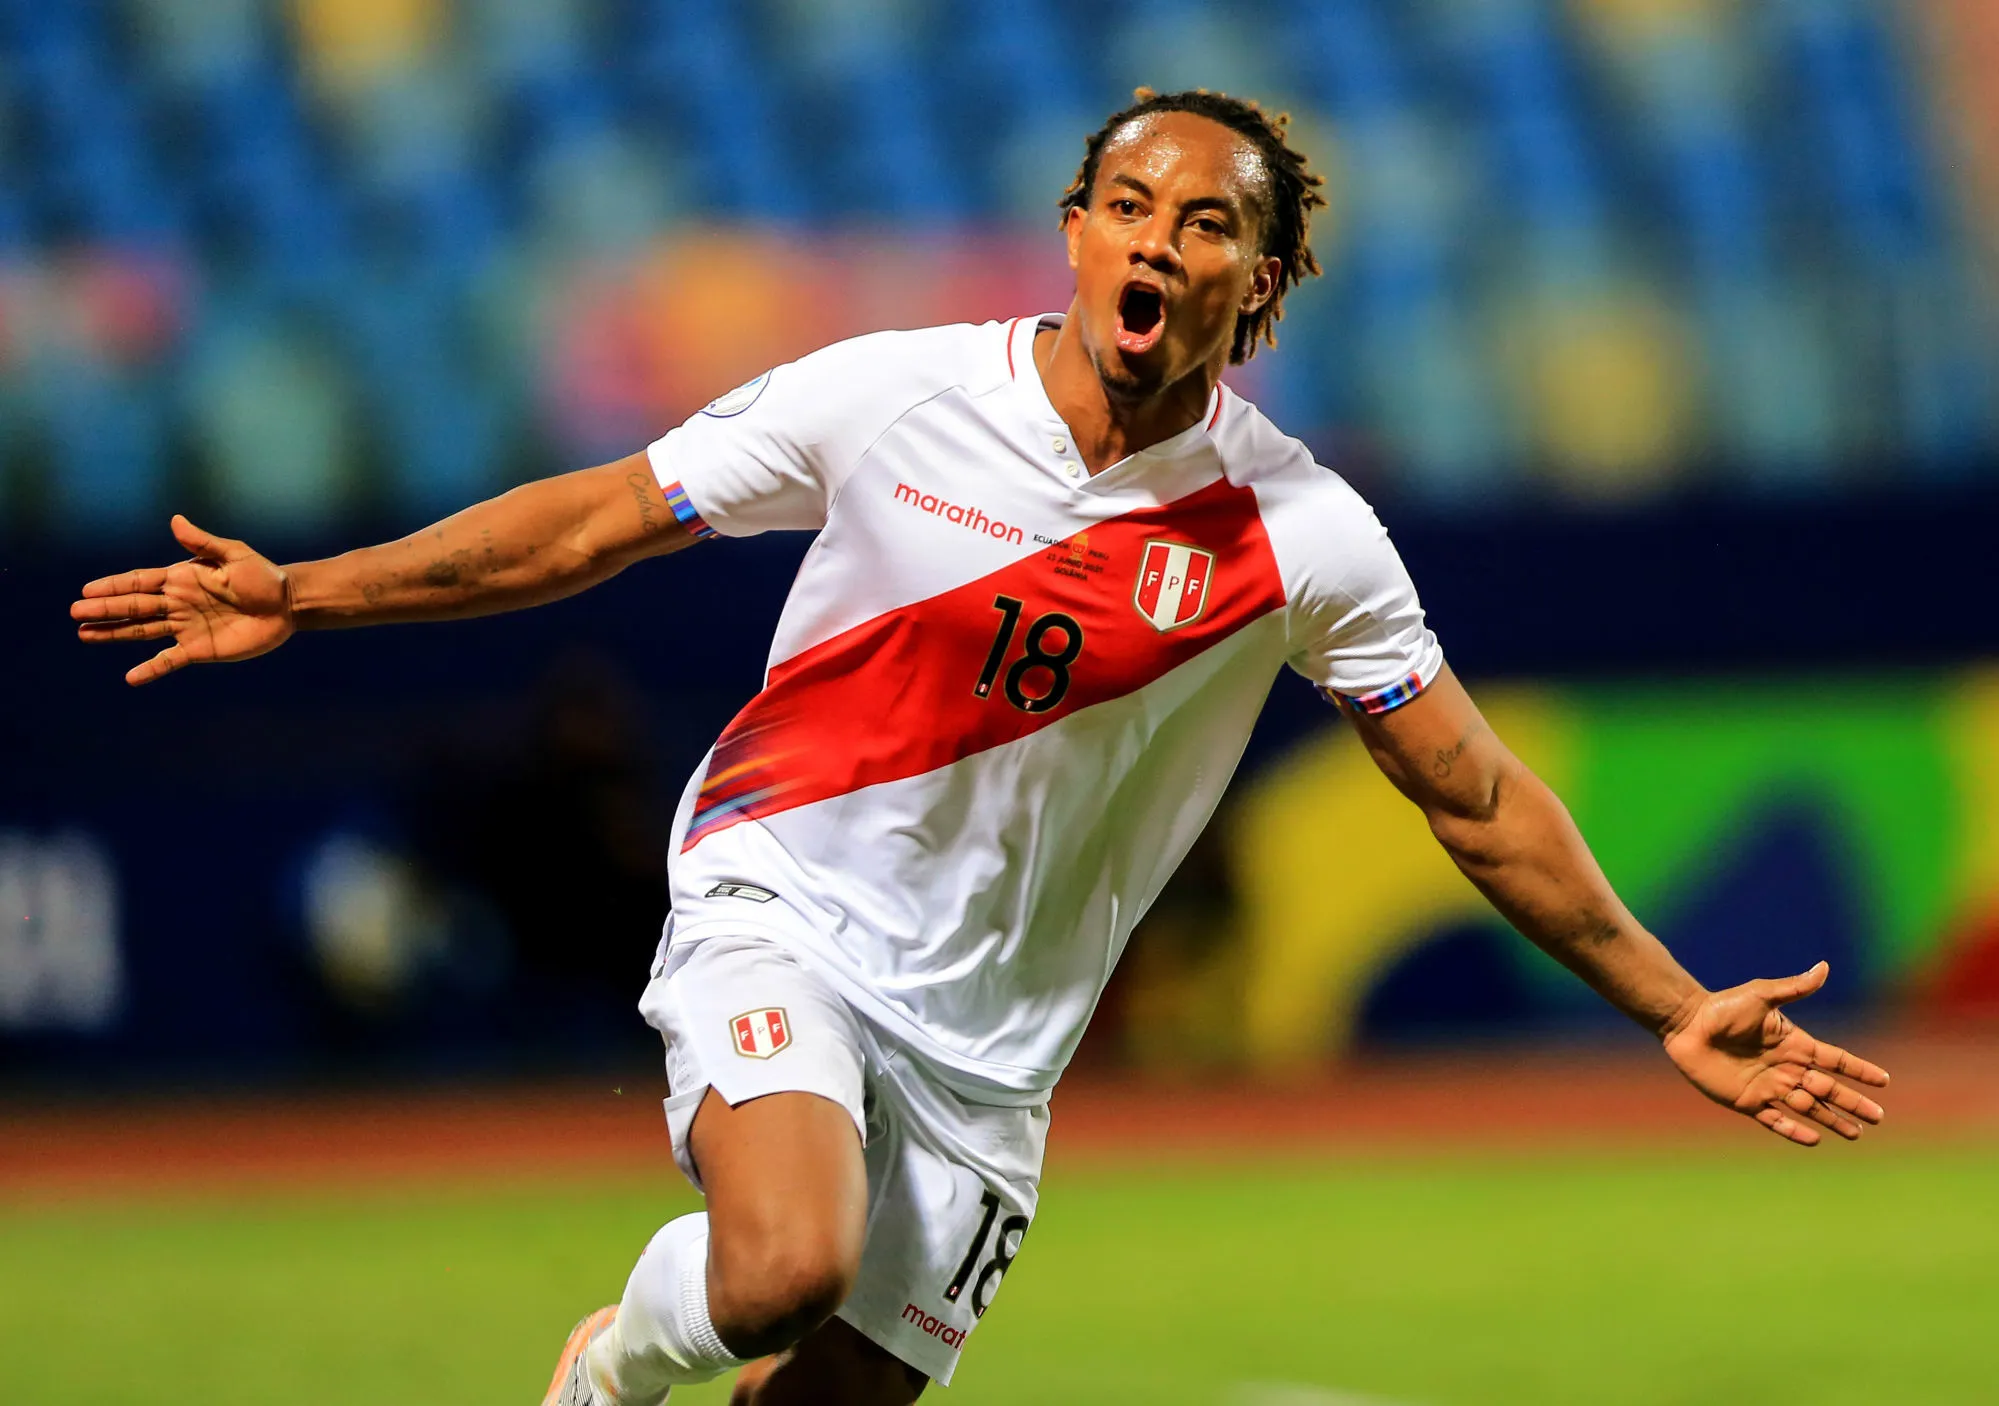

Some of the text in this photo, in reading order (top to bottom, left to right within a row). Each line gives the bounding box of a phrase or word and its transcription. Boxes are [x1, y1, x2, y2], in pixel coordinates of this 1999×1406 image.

[894, 482, 1023, 546] marathon
[1033, 534, 1069, 549] ECUADOR
[972, 592, 1084, 714] 18
[943, 1189, 1029, 1320] 18
